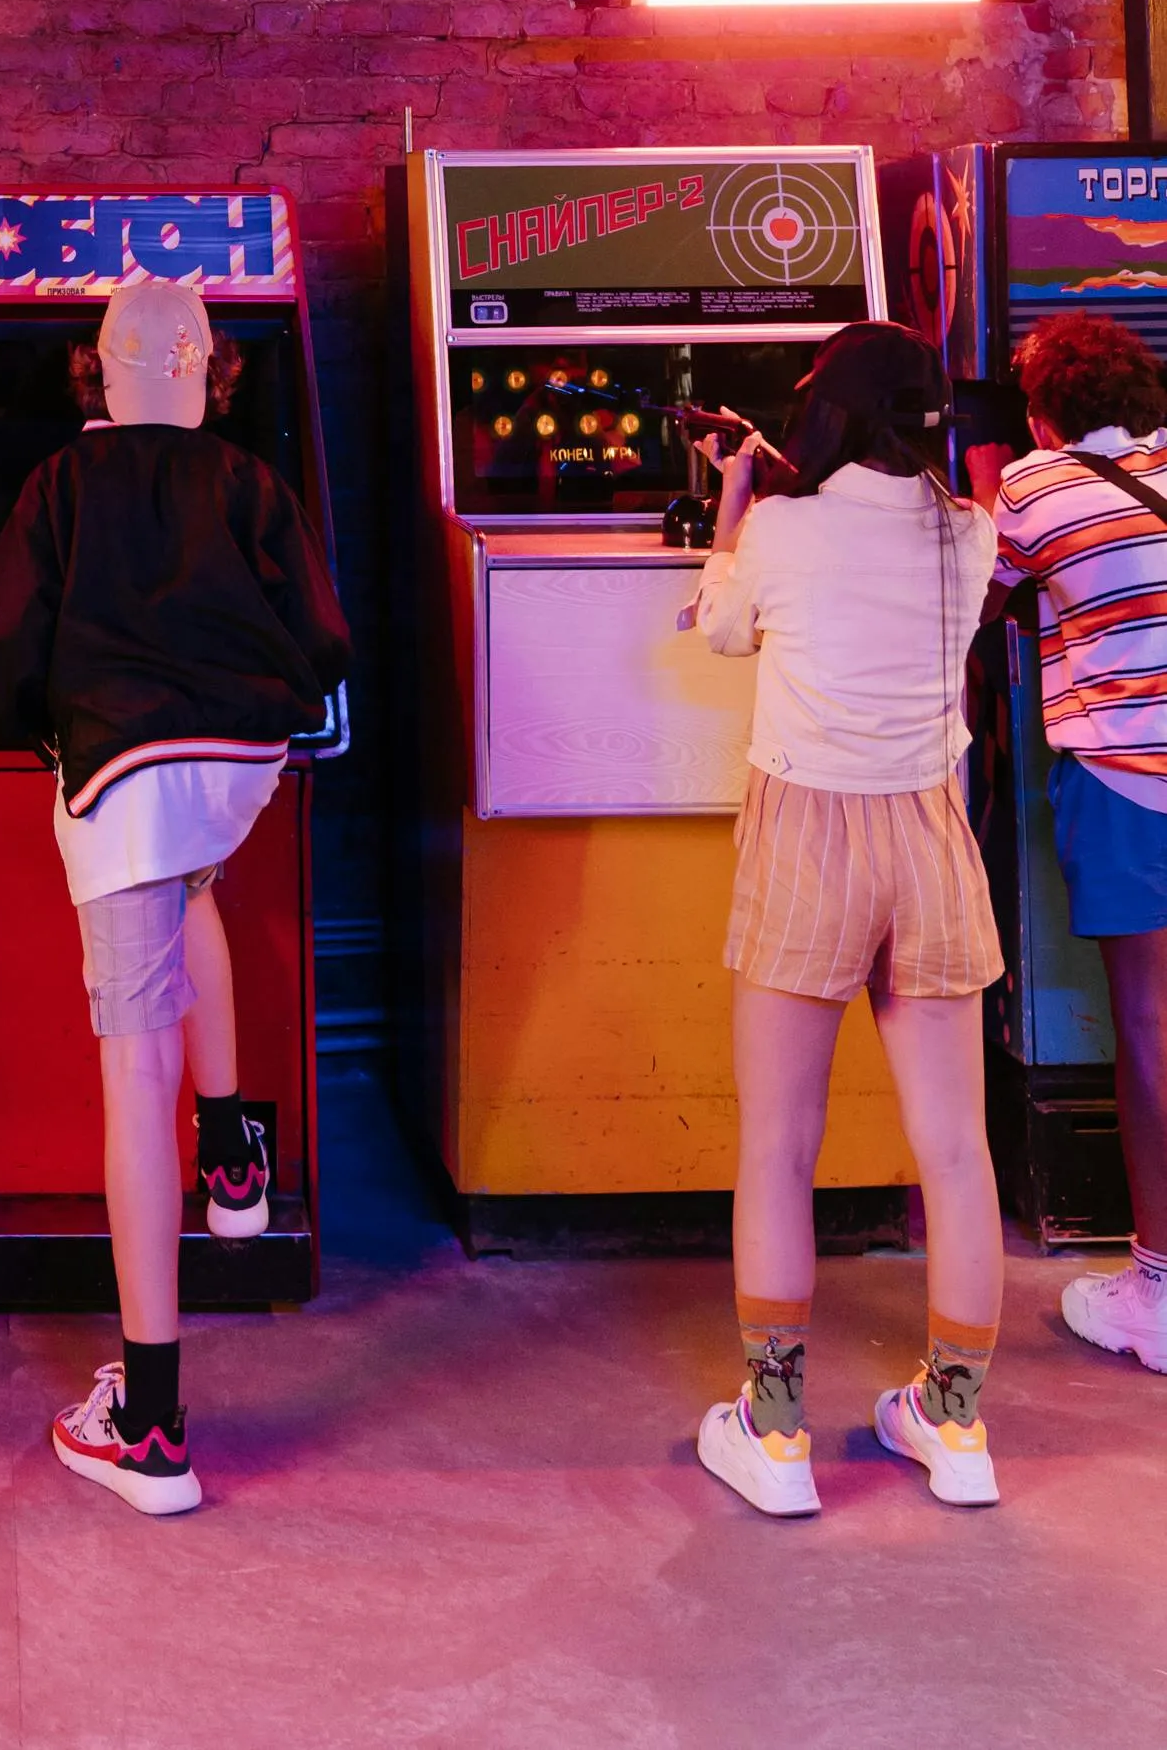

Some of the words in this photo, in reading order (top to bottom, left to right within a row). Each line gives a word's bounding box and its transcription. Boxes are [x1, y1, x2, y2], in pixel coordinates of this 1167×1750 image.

[456, 174, 705, 280] СНАЙПЕР-2
[47, 287, 85, 296] ПРИЗОВАЯ
[550, 447, 594, 462] КОНЕЦ
[603, 447, 641, 461] ИГРЫ
[1138, 1266, 1162, 1282] FILA
